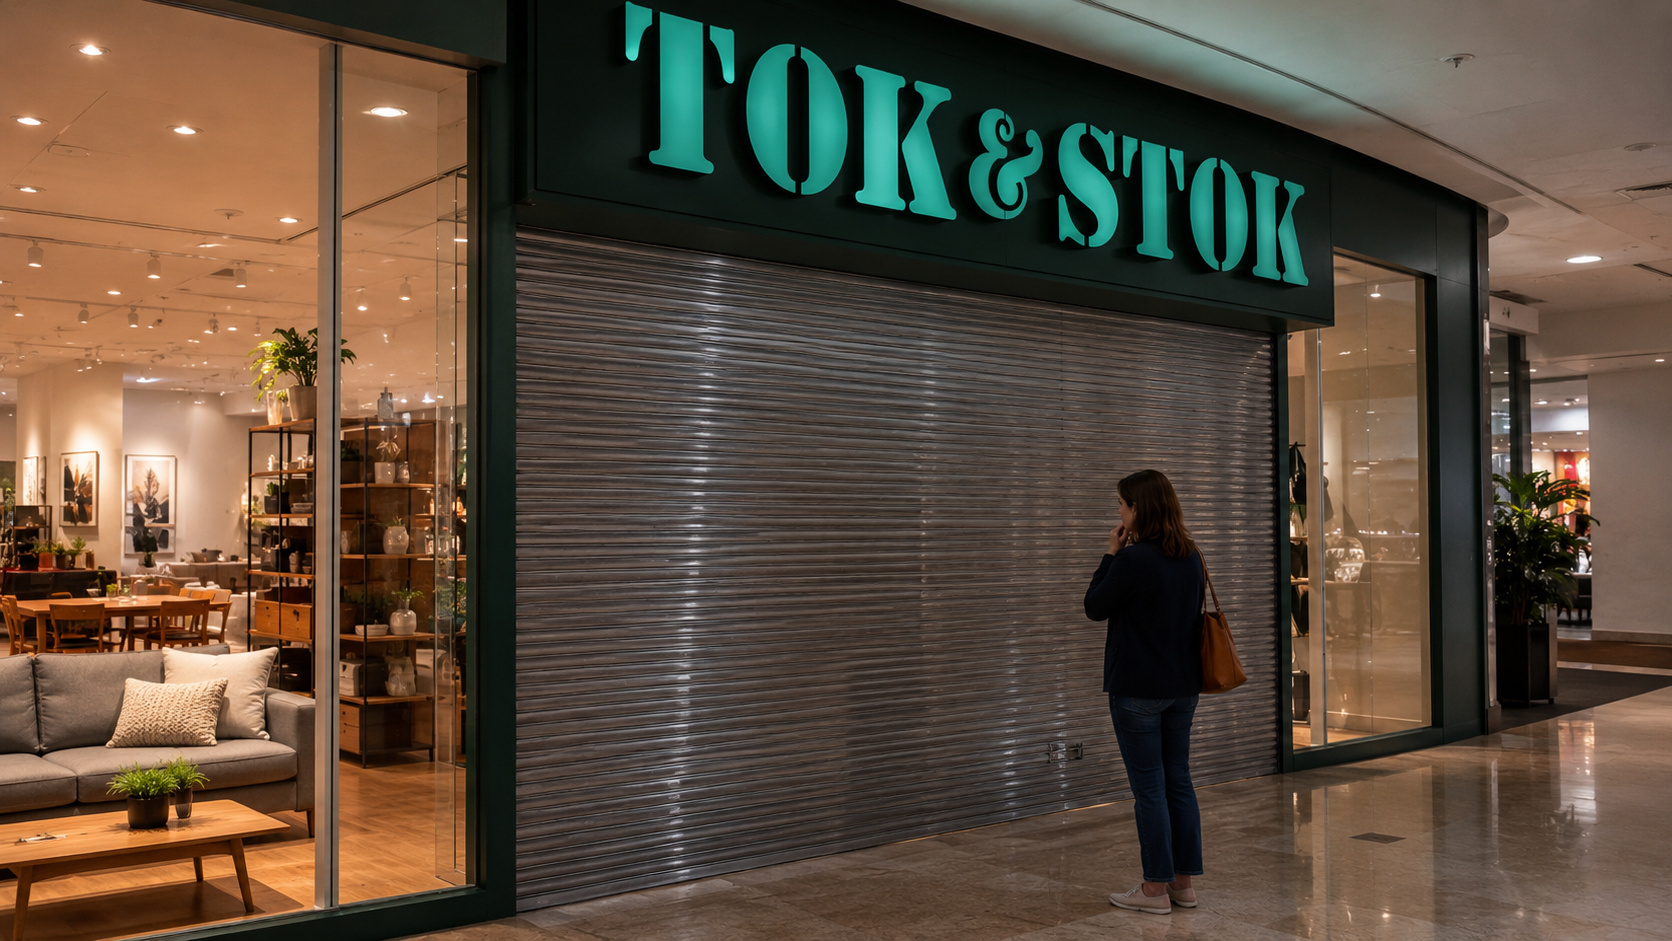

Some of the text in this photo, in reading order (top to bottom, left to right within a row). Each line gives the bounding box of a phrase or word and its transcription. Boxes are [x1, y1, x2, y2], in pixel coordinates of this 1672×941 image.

[625, 1, 1309, 287] TOK & STOK
